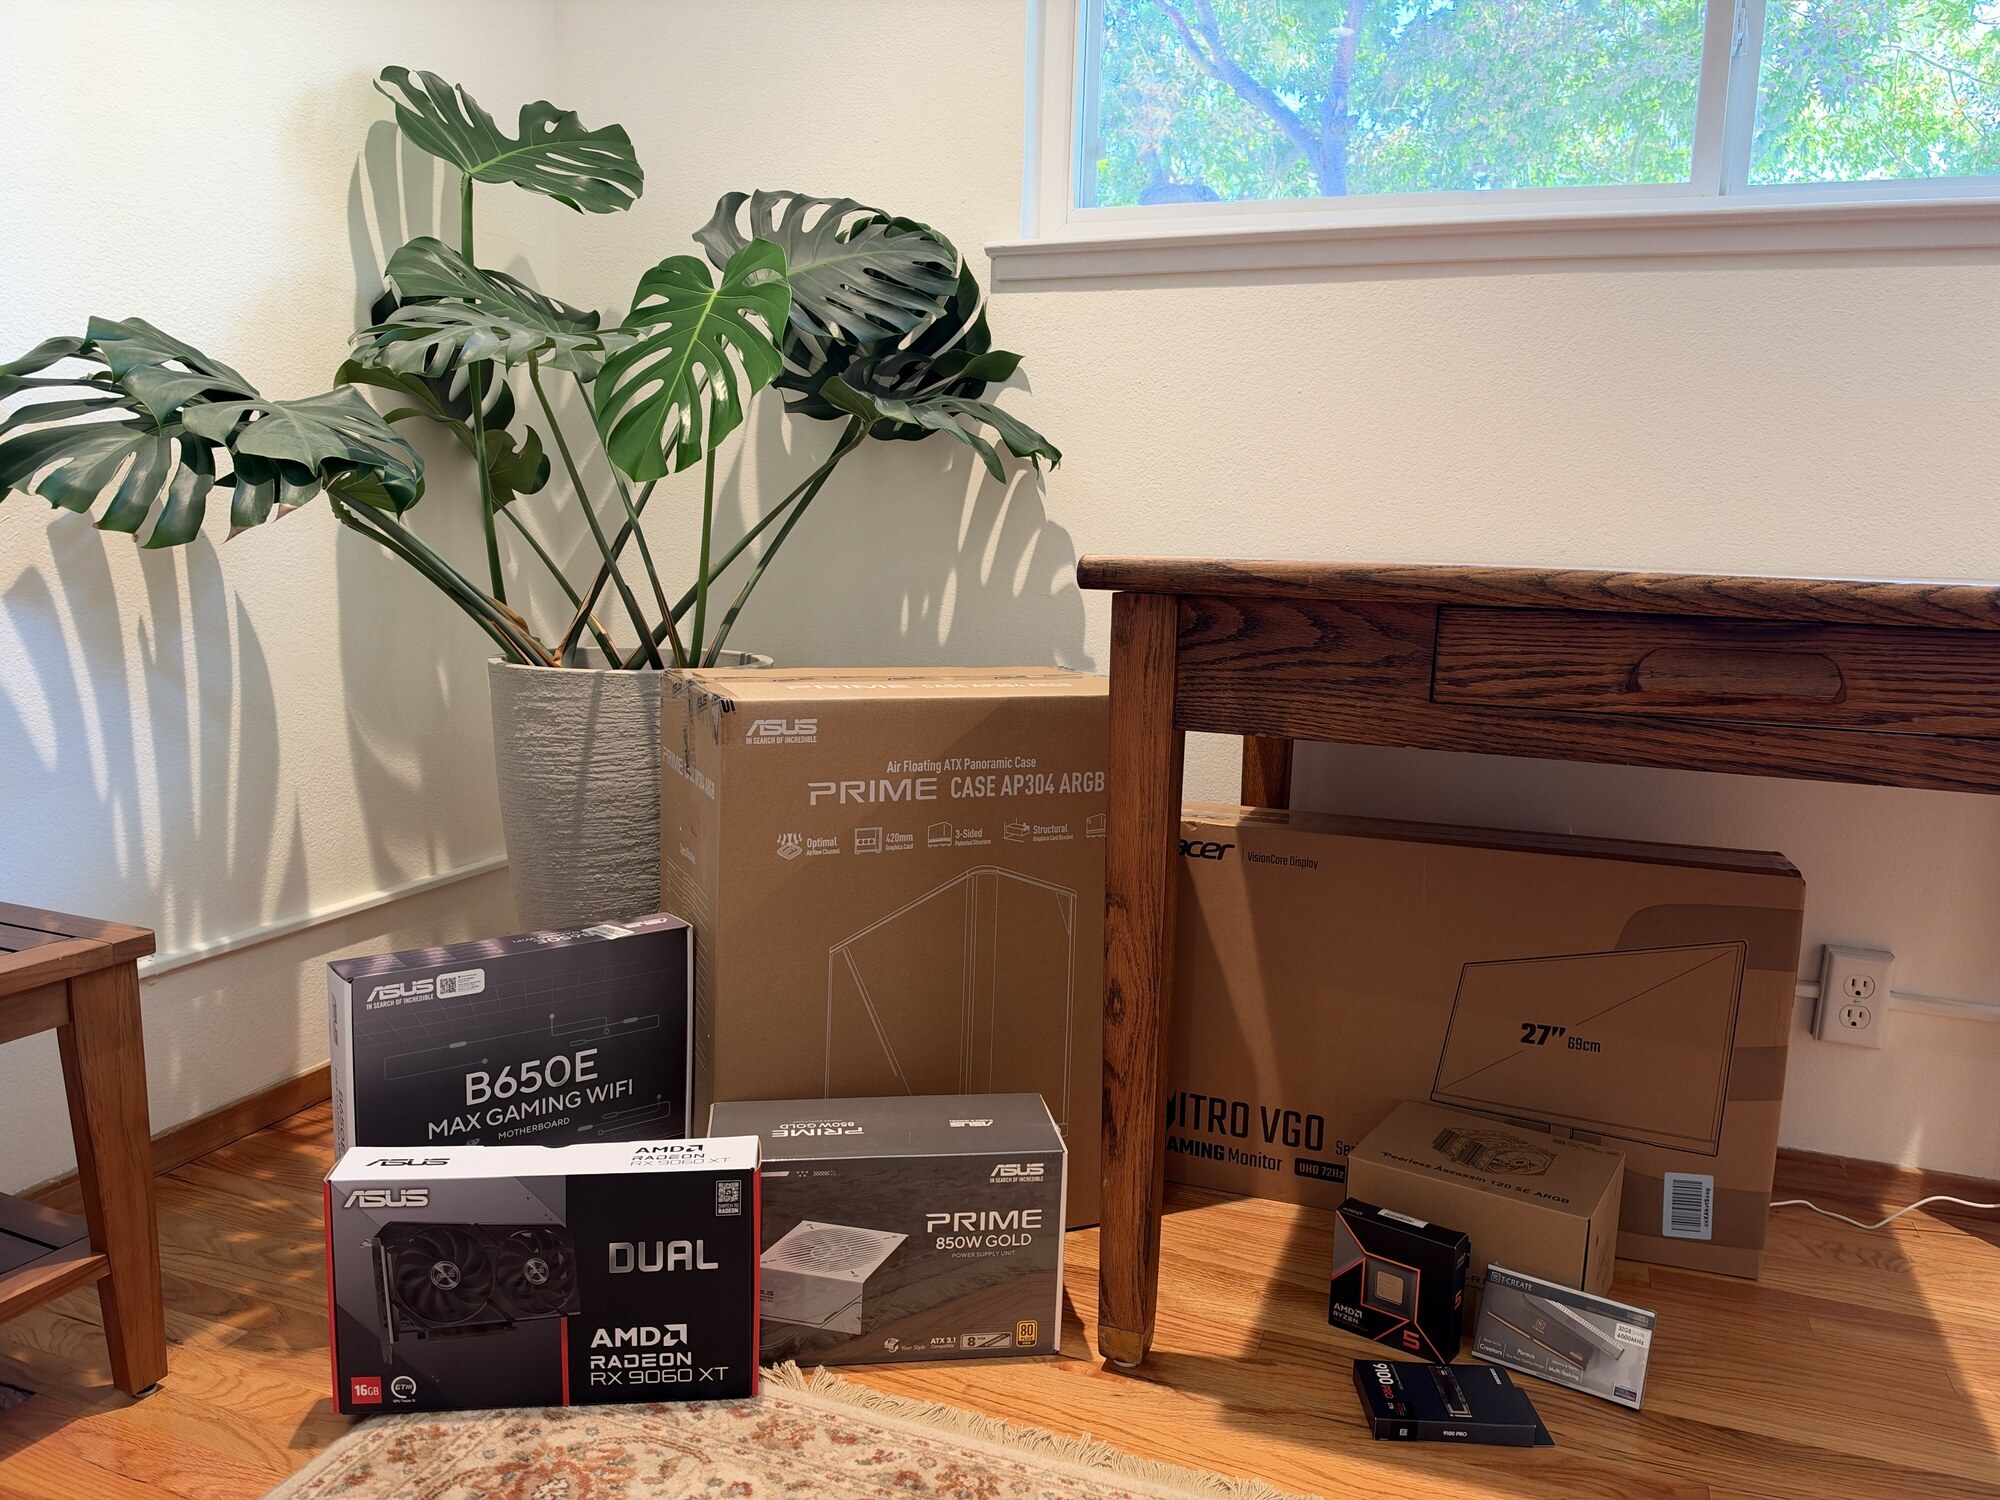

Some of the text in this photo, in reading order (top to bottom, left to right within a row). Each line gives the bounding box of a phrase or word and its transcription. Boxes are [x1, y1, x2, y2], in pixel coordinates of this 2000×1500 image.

[746, 719, 817, 736] ASUS
[746, 736, 752, 744] IN
[753, 736, 775, 744] SEARCH
[785, 735, 817, 744] INCREDIBLE
[887, 756, 1036, 774] Air Floating ATX Panoramic Case
[808, 771, 1105, 806] PRIME CASE AP304 ARGB
[955, 828, 983, 839] 3-Sided
[1032, 823, 1068, 834] Structural
[806, 836, 837, 849] Optimal
[886, 833, 913, 844] 420mm
[1289, 856, 1318, 870] Display
[367, 978, 434, 1002] ASUS
[374, 999, 394, 1009] SEARCH
[395, 998, 402, 1006] OF
[403, 994, 434, 1005] INCREDIBLE
[1520, 1022, 1601, 1053] 27" 69cm
[465, 1048, 598, 1106] B650E
[428, 1078, 634, 1140] MAX GAMING WIFI
[498, 1117, 570, 1140] MOTHERBOARD
[771, 1126, 865, 1138] PRIME
[1261, 1106, 1324, 1152] VGO
[632, 1153, 705, 1161] RADEON
[635, 1145, 686, 1154] AMD
[1166, 1135, 1283, 1172] AMING Monitor
[365, 1157, 451, 1167] ASUS
[991, 1163, 1045, 1177] ASUS
[1018, 1175, 1044, 1183] INCREDIBLE
[1299, 1162, 1344, 1180] UHD 72Hz
[1380, 1151, 1570, 1204] Peerless Assassin 120 SE ARGB
[343, 1189, 429, 1209] ASUS
[925, 1209, 1043, 1234] PRIME
[936, 1233, 1032, 1251] 850W GOLD
[608, 1239, 719, 1274] DUAL
[1333, 1302, 1356, 1316] AMD
[1333, 1310, 1359, 1325] RYZEN
[590, 1325, 664, 1349] AMD
[1020, 1324, 1034, 1336] 80
[930, 1336, 957, 1345] ATX 3.1
[967, 1336, 976, 1347] 8
[1403, 1329, 1420, 1350] 5
[590, 1352, 692, 1370] RADEON
[590, 1366, 730, 1386] RX 9060 XT
[1372, 1363, 1395, 1386] 9100
[354, 1384, 380, 1397] 16GB
[1380, 1384, 1395, 1400] PRO
